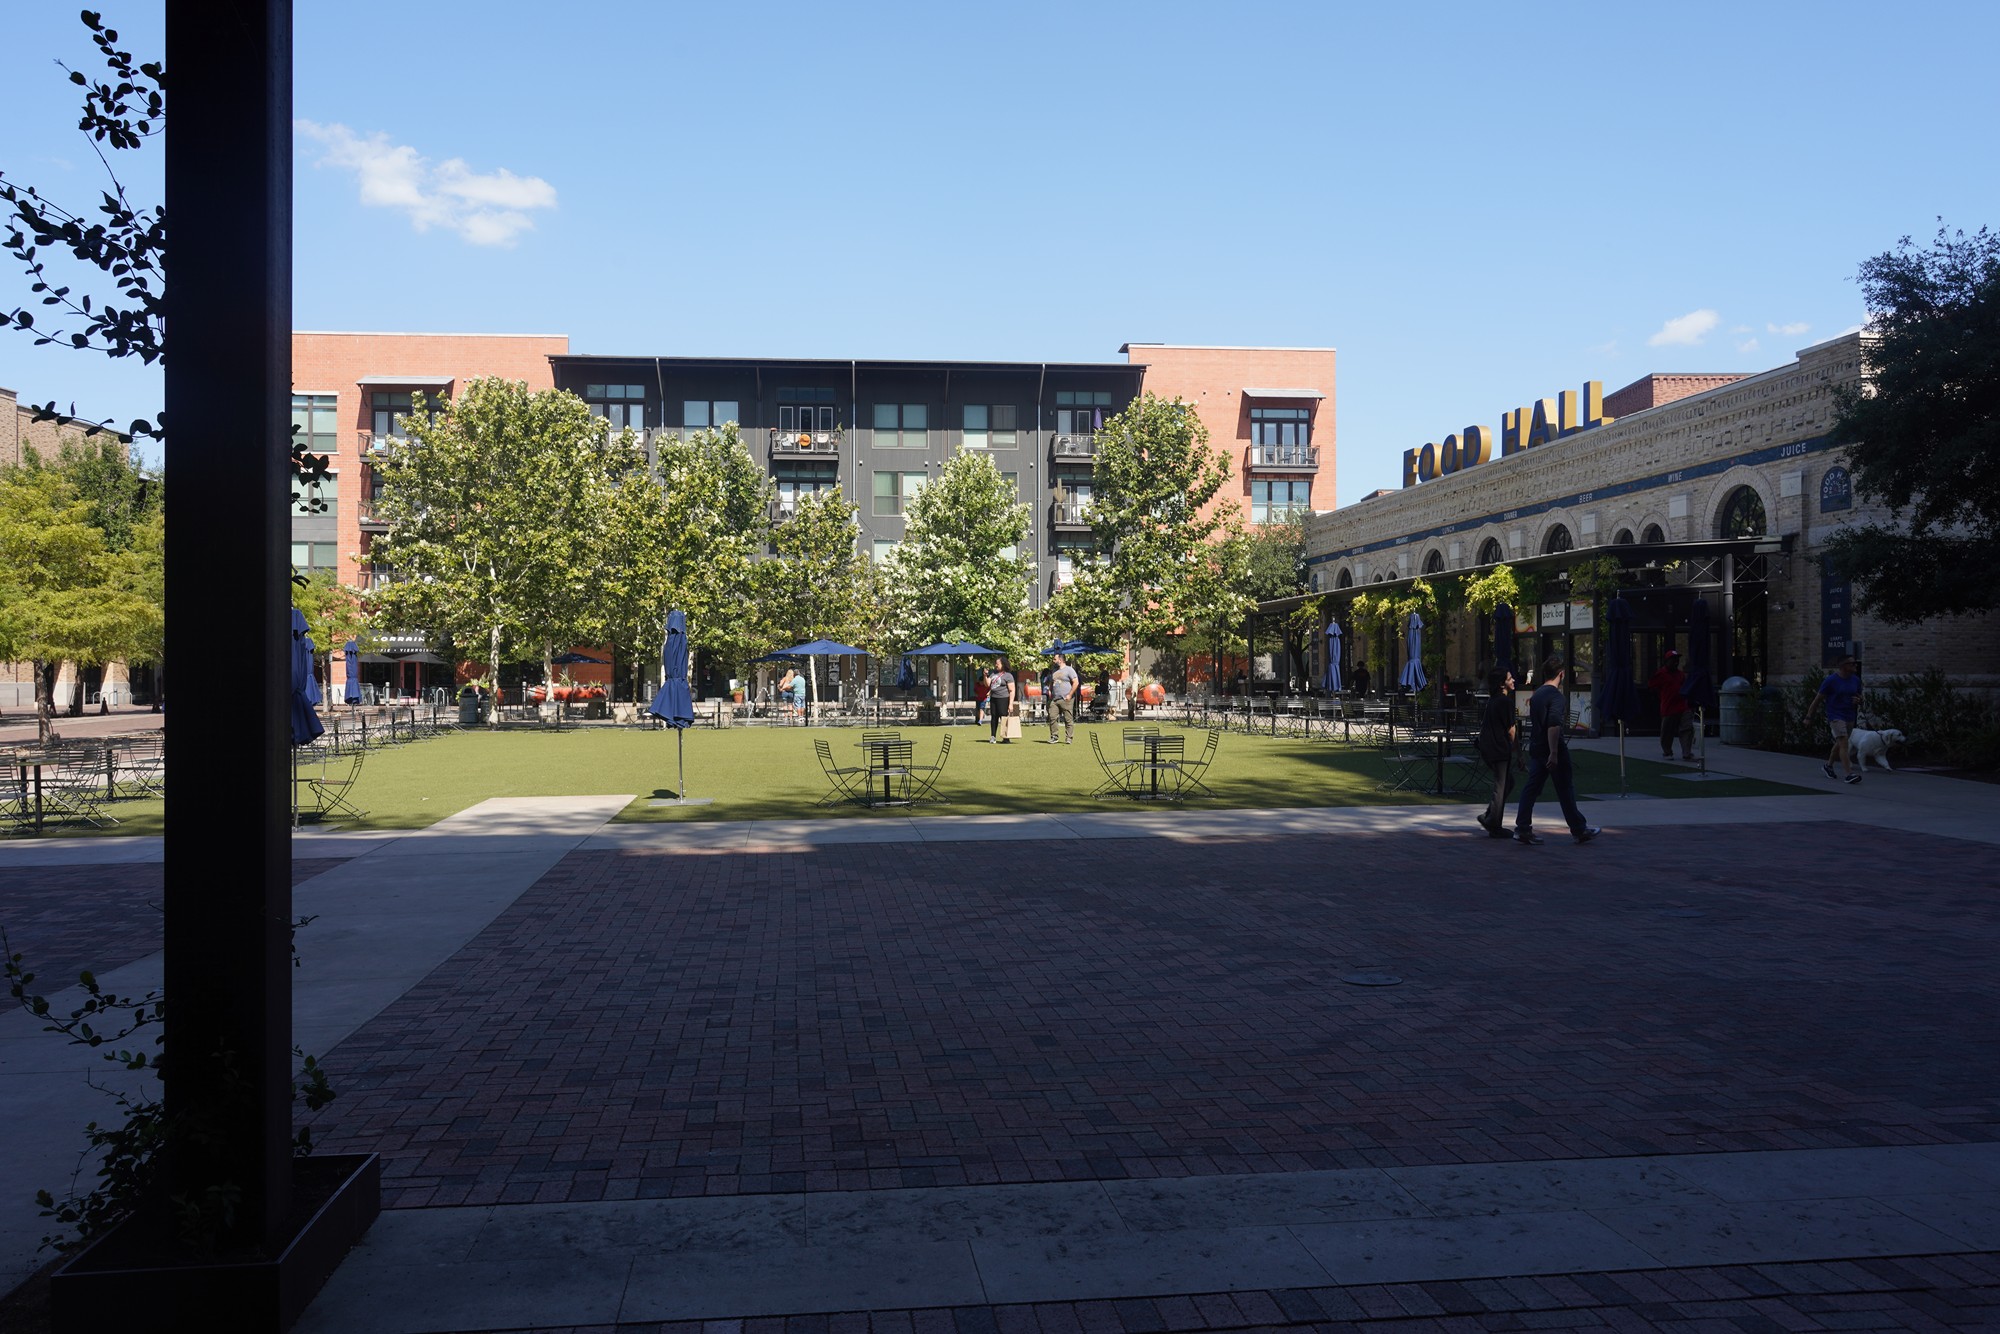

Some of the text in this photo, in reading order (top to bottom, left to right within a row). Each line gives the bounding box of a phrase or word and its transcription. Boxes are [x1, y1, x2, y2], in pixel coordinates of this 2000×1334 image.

[1403, 380, 1615, 489] FOOD HALL
[1780, 442, 1806, 457] JUICE
[1667, 471, 1682, 483] WINE
[1579, 493, 1593, 503] BEER
[1503, 510, 1518, 521] DINNER
[1543, 609, 1564, 621] park bar
